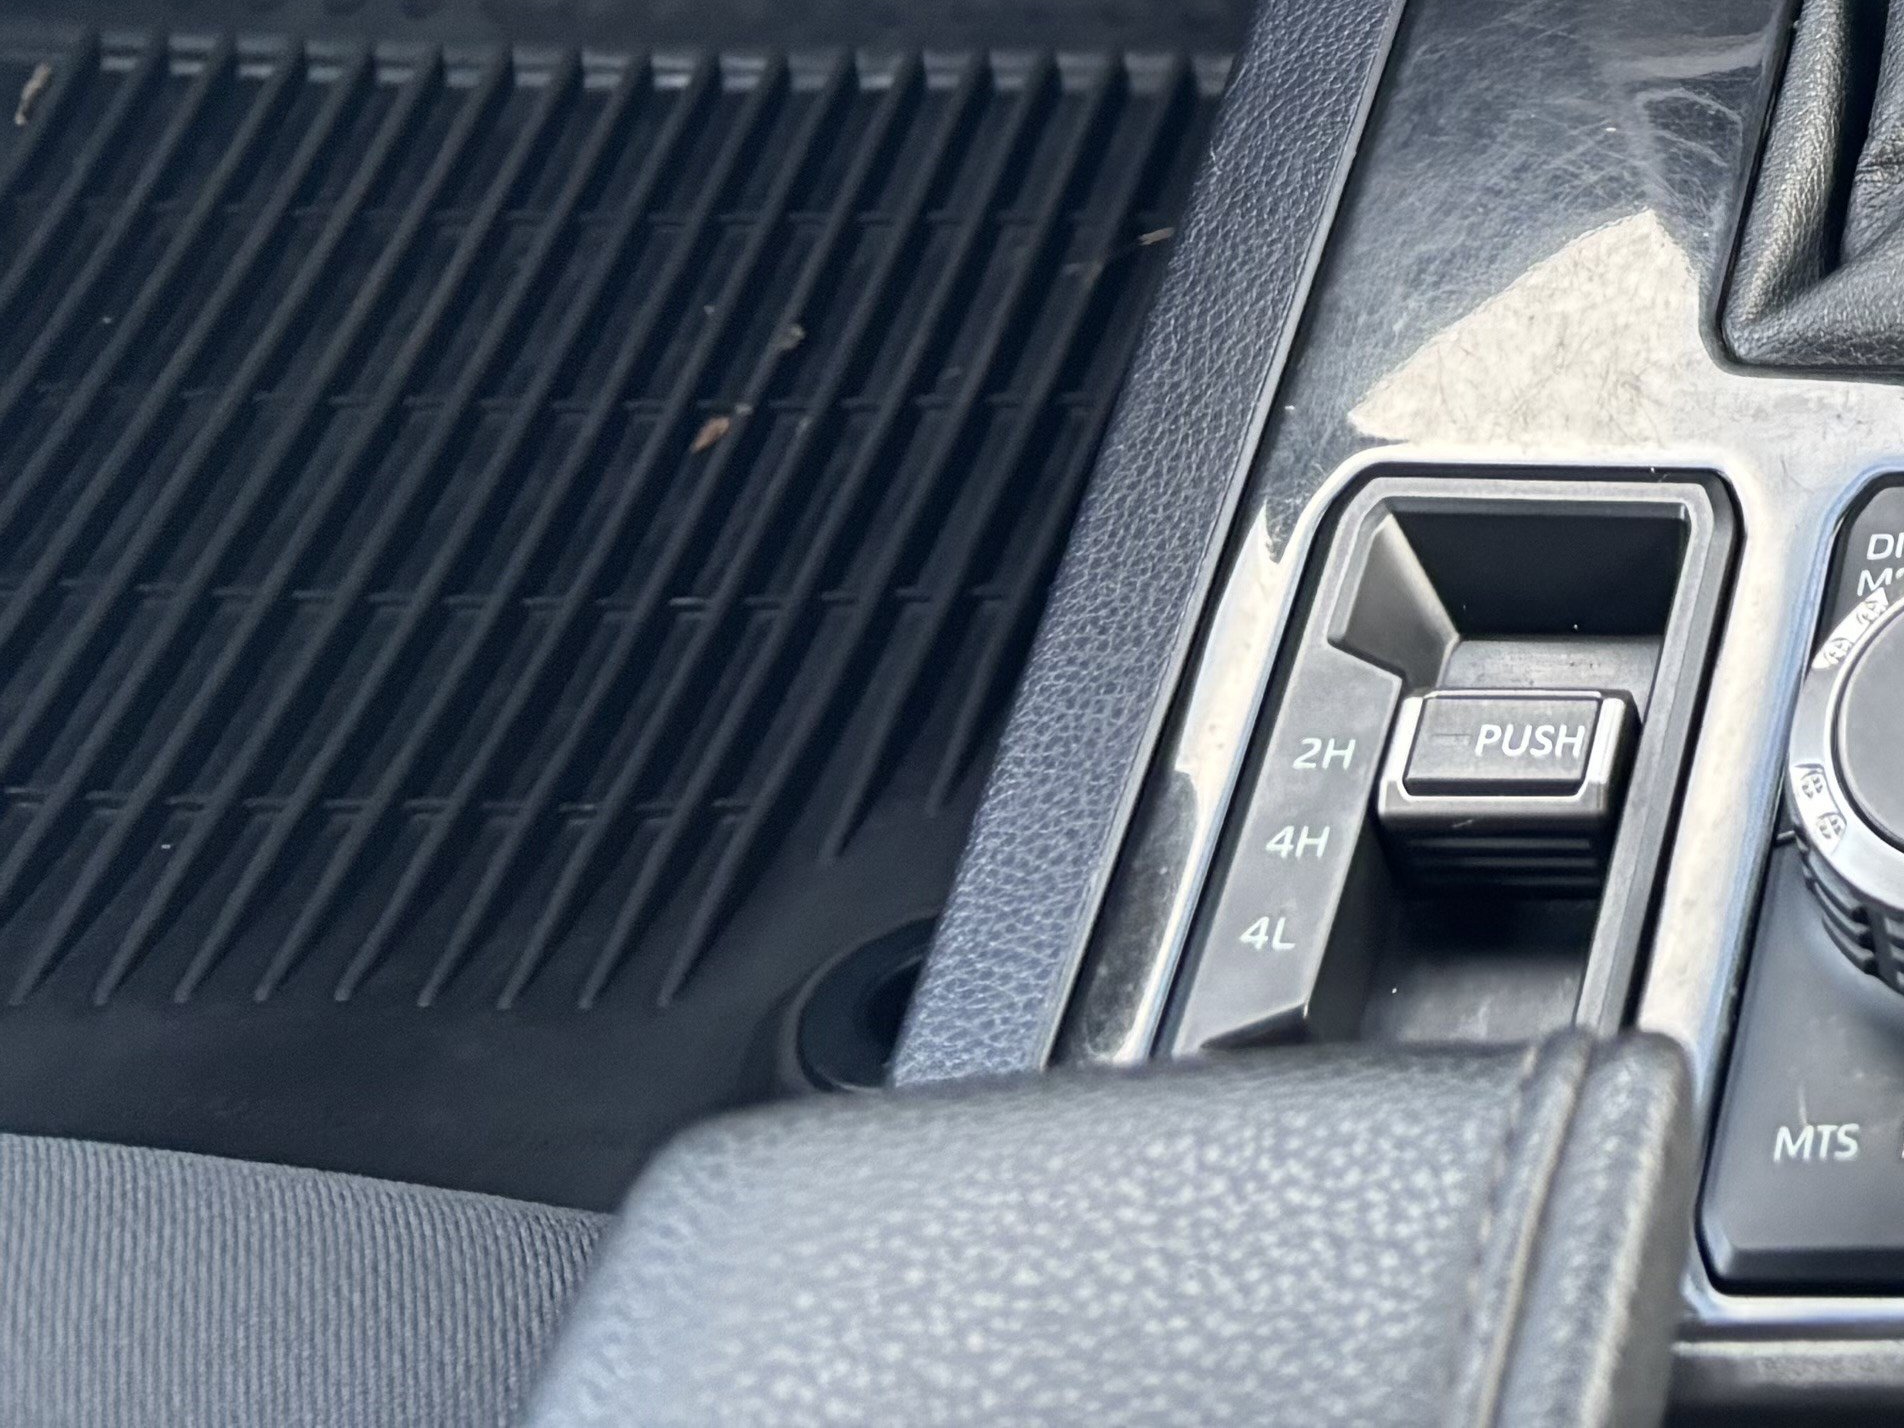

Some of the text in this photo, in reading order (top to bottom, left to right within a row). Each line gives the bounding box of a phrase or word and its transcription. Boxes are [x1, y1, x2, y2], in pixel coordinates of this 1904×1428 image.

[1292, 738, 1355, 769] 2H
[1475, 724, 1585, 758] PUSH
[1266, 826, 1330, 858] 4H
[1240, 917, 1295, 950] 4L
[1773, 1123, 1860, 1162] MTS
